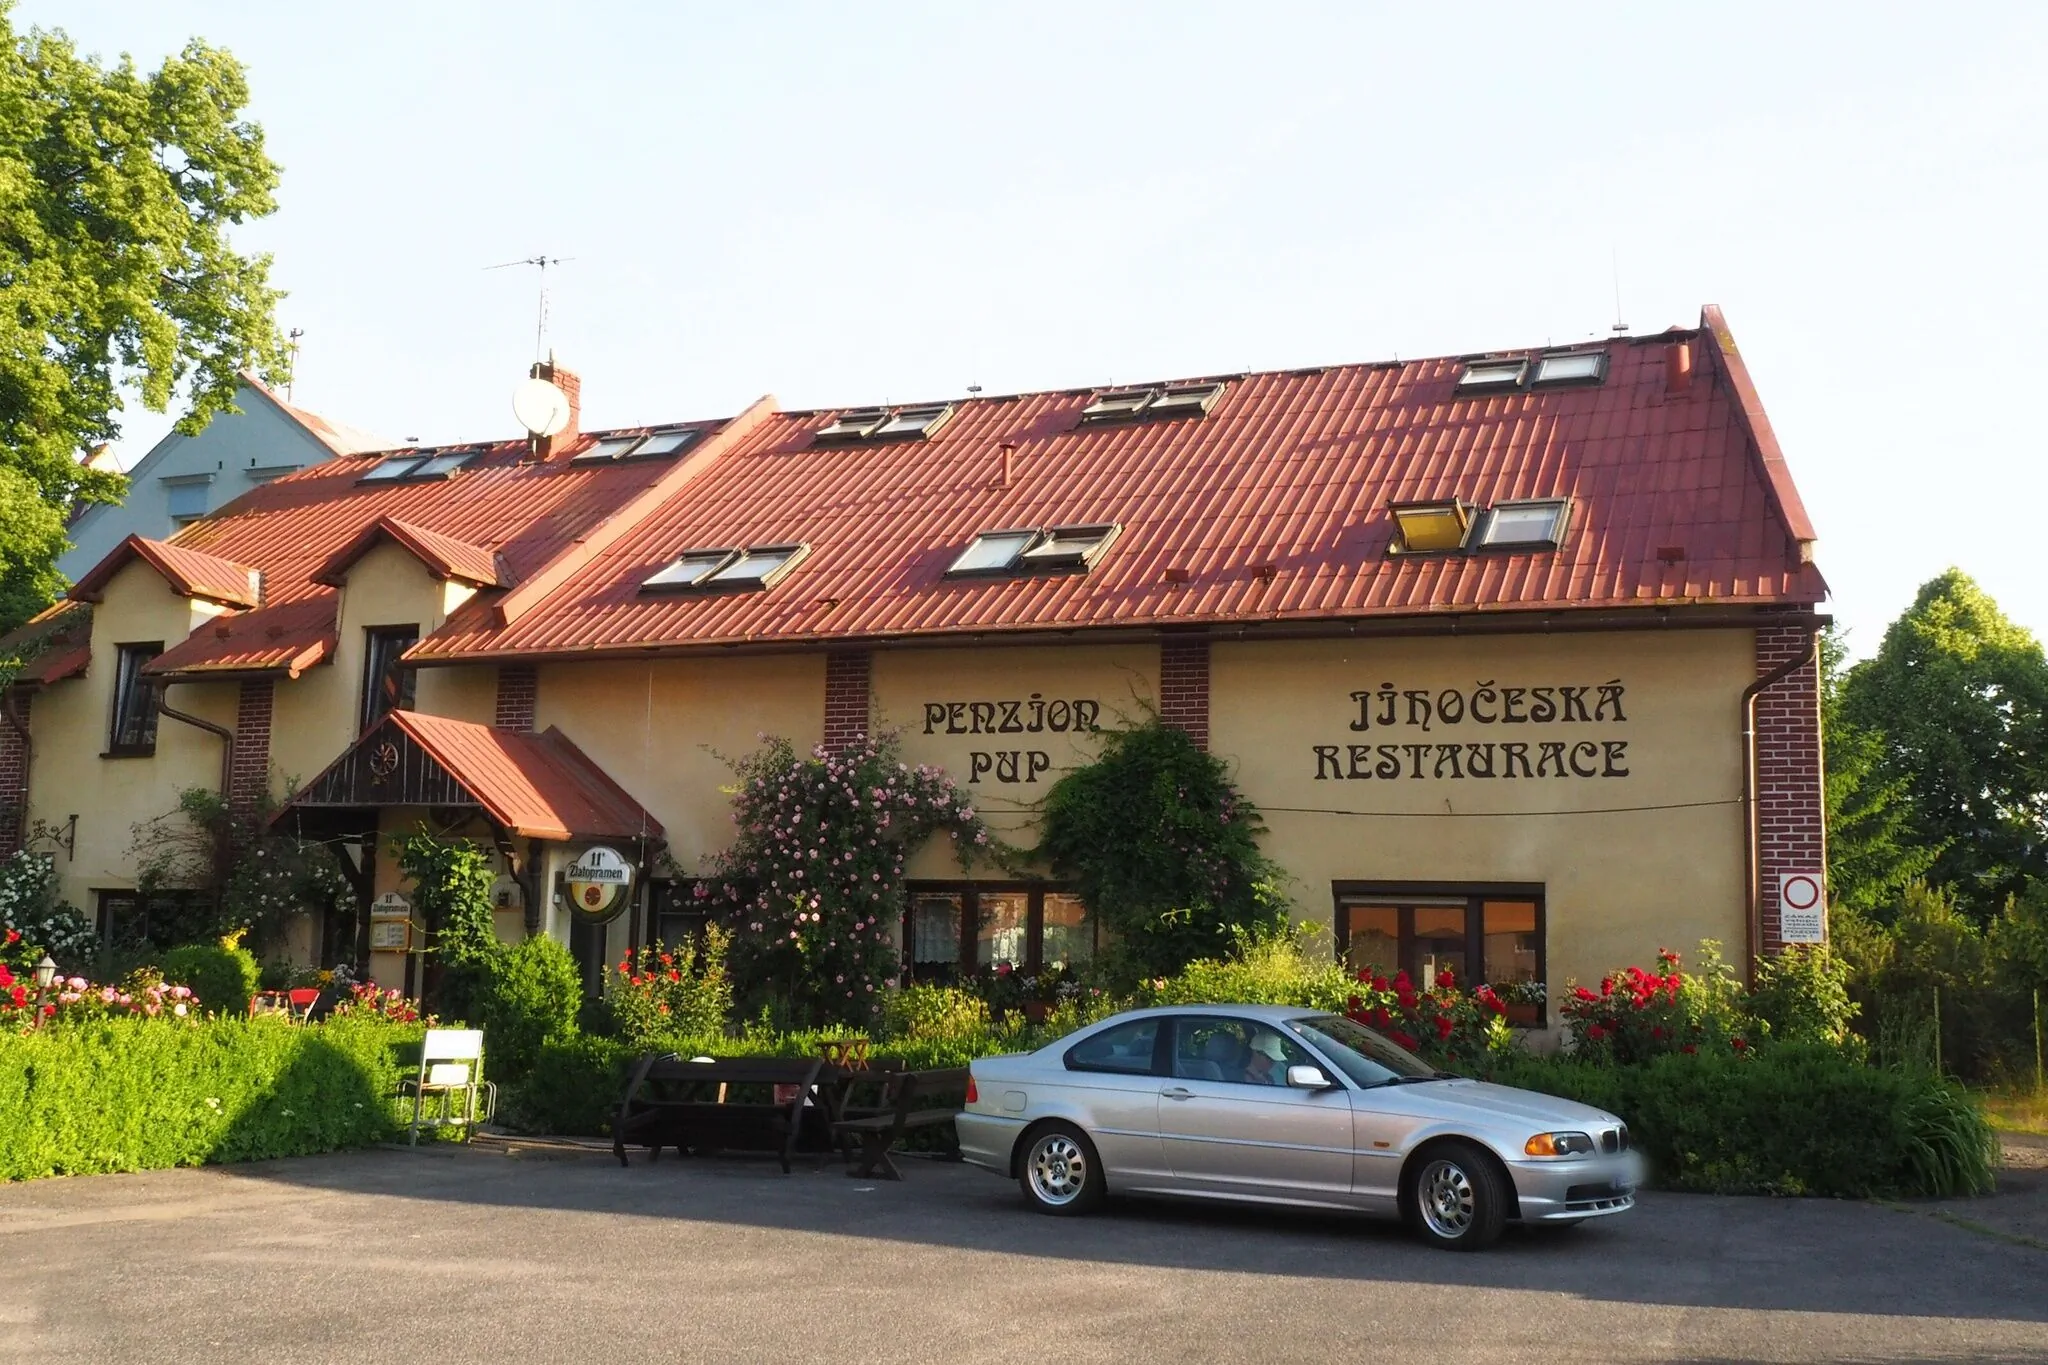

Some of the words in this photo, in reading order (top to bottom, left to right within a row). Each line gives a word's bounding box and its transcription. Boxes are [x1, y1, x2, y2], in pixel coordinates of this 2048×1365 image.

[1349, 679, 1628, 732] JIHOČESKÁ
[968, 751, 1050, 784] PUP
[1313, 741, 1630, 780] RESTAURACE
[570, 865, 623, 880] Zlatopramen
